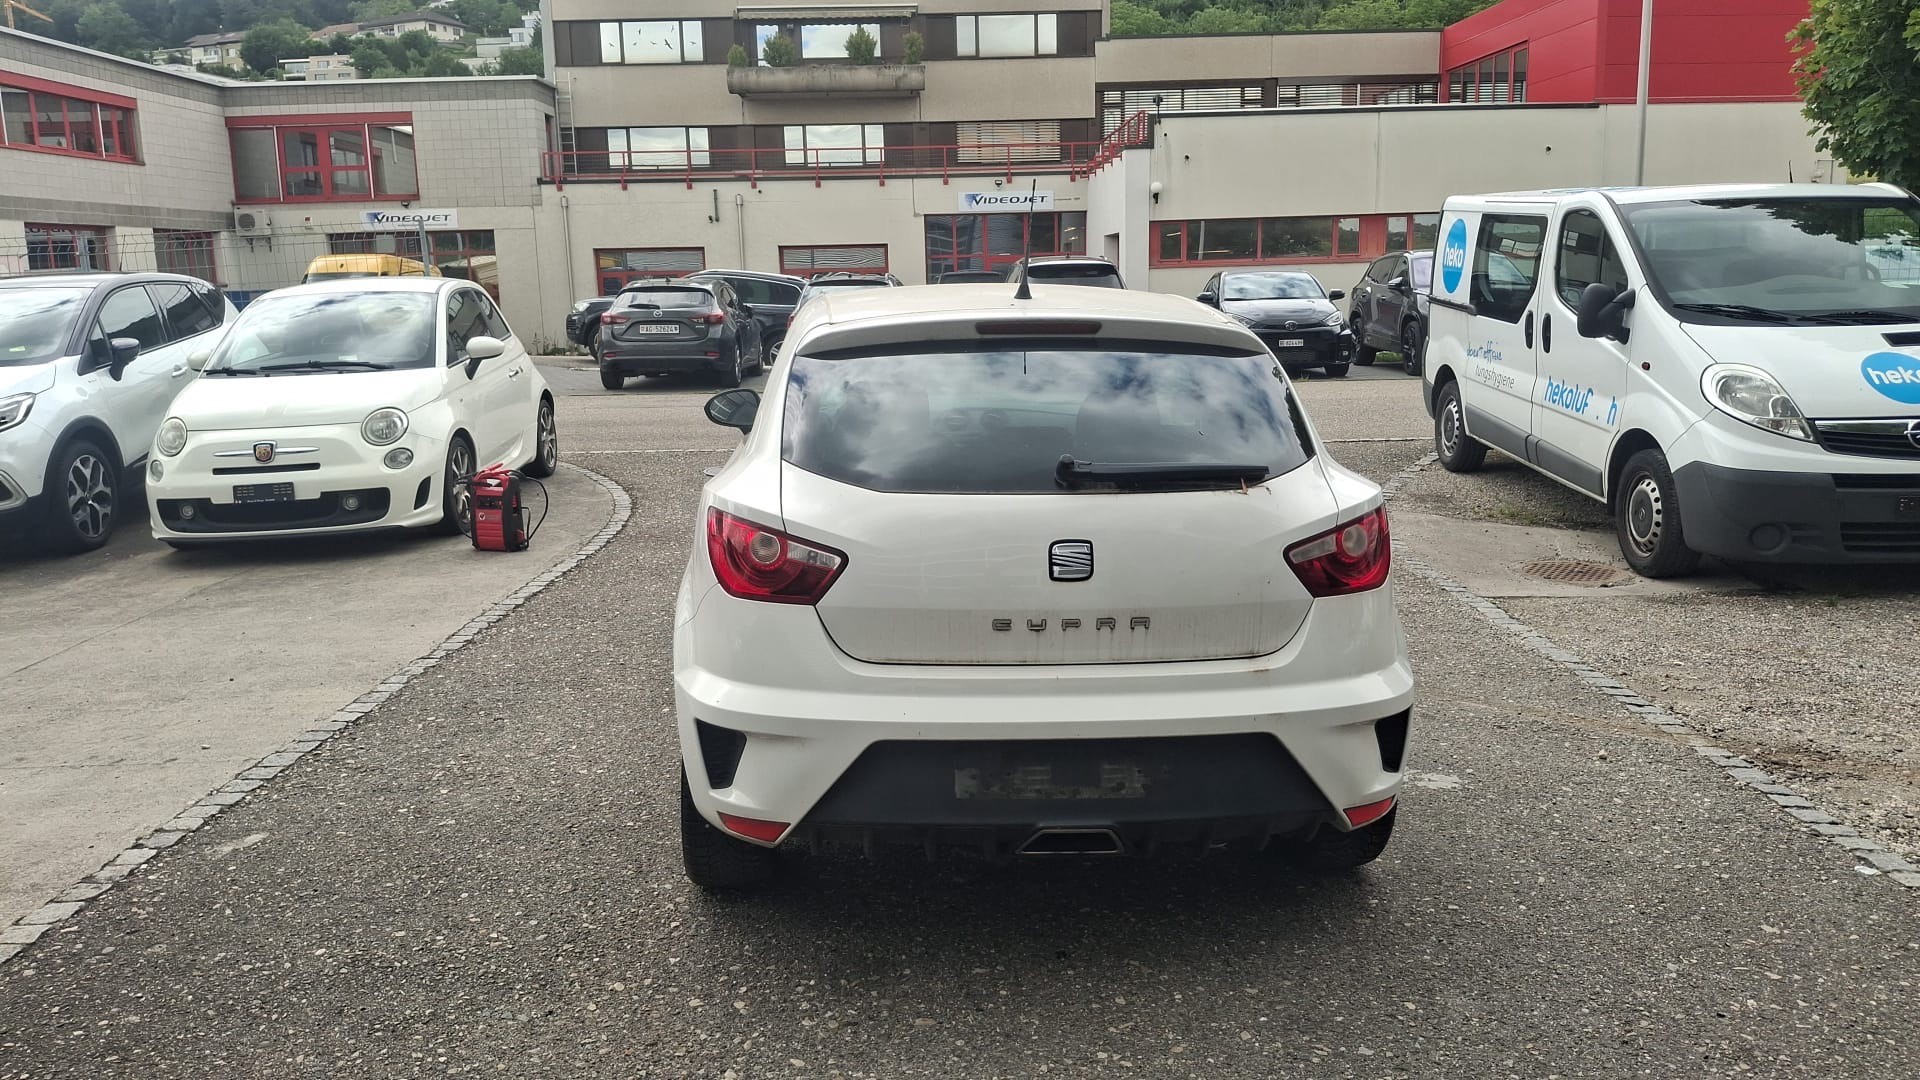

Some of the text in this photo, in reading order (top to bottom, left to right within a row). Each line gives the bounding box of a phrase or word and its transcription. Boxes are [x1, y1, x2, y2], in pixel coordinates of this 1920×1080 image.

[974, 195, 1048, 206] VIDEOJET
[376, 214, 451, 225] VIDEOJET
[1444, 241, 1464, 268] heko
[1866, 366, 1920, 385] hek
[991, 616, 1151, 632] CUPRA
